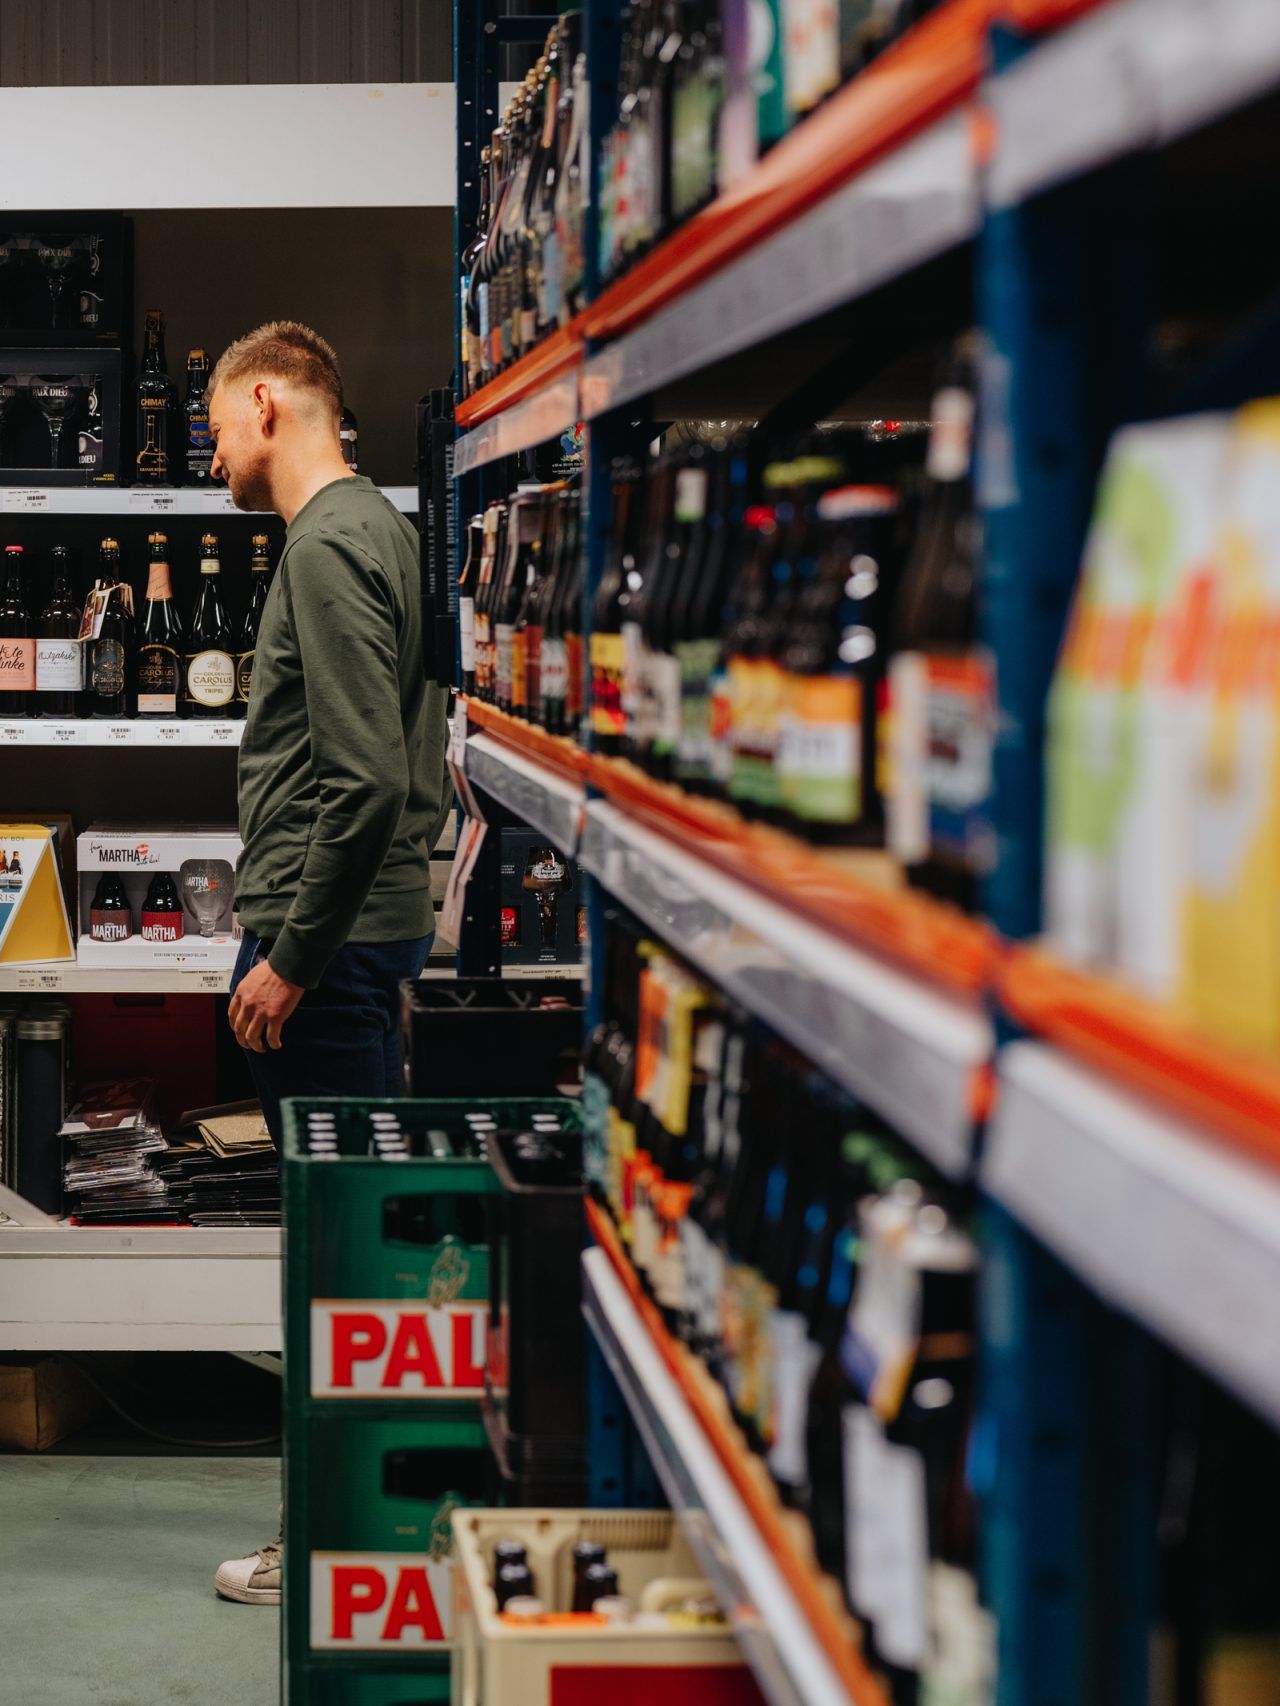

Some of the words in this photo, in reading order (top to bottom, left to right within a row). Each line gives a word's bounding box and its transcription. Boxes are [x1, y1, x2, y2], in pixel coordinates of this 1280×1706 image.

[140, 398, 166, 407] CHIMAY
[189, 414, 209, 422] CHIMA
[193, 676, 233, 686] CAROLUS
[99, 849, 141, 863] MARTHA
[92, 925, 128, 938] MARTHA
[142, 926, 177, 940] MARTHA
[330, 1312, 494, 1389] PAL
[330, 1565, 454, 1641] PA
